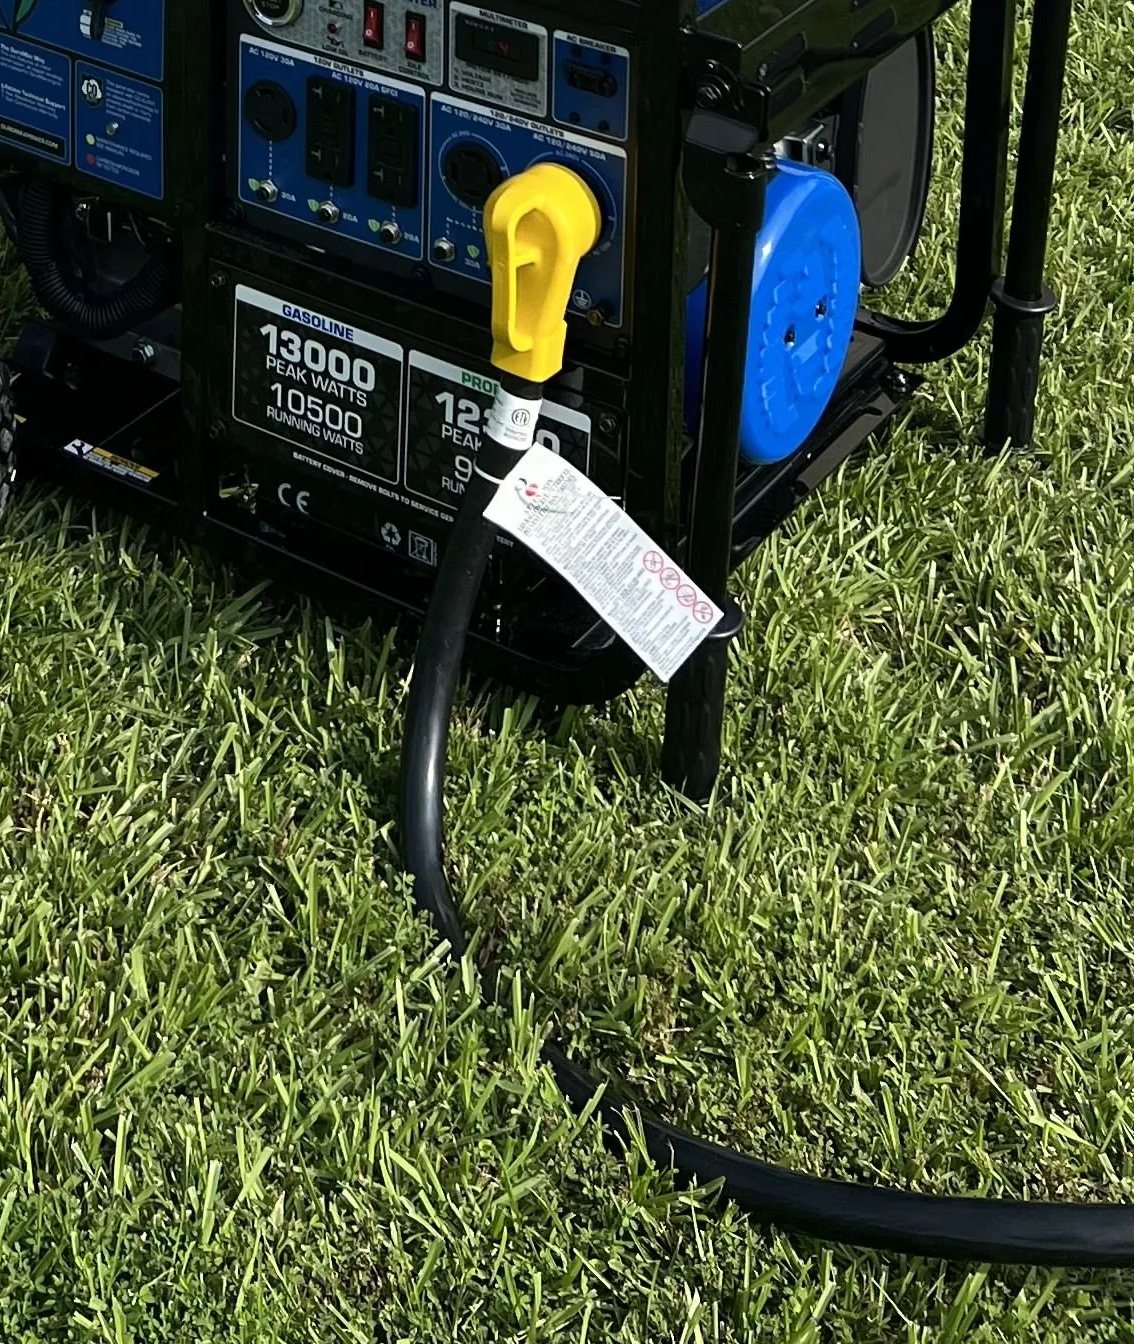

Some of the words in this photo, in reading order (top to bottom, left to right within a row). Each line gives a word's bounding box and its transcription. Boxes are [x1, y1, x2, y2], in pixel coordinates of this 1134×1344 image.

[479, 10, 529, 30] MULTIMETER
[567, 34, 578, 43] AC
[249, 47, 259, 55] AC
[331, 71, 343, 80] AC
[333, 61, 365, 77] OUTLETS
[441, 104, 452, 114] AC
[530, 120, 565, 138] OUTLETS
[533, 132, 545, 141] AC
[282, 304, 354, 342] GASOLINE
[260, 323, 376, 392] 13000
[266, 355, 308, 385] PEAK
[311, 372, 367, 407] WATTS
[270, 382, 363, 438] 10500
[266, 405, 321, 437] RUNNING
[322, 427, 364, 456] WATTS
[293, 451, 322, 469] BATTERY
[401, 495, 410, 505] TO
